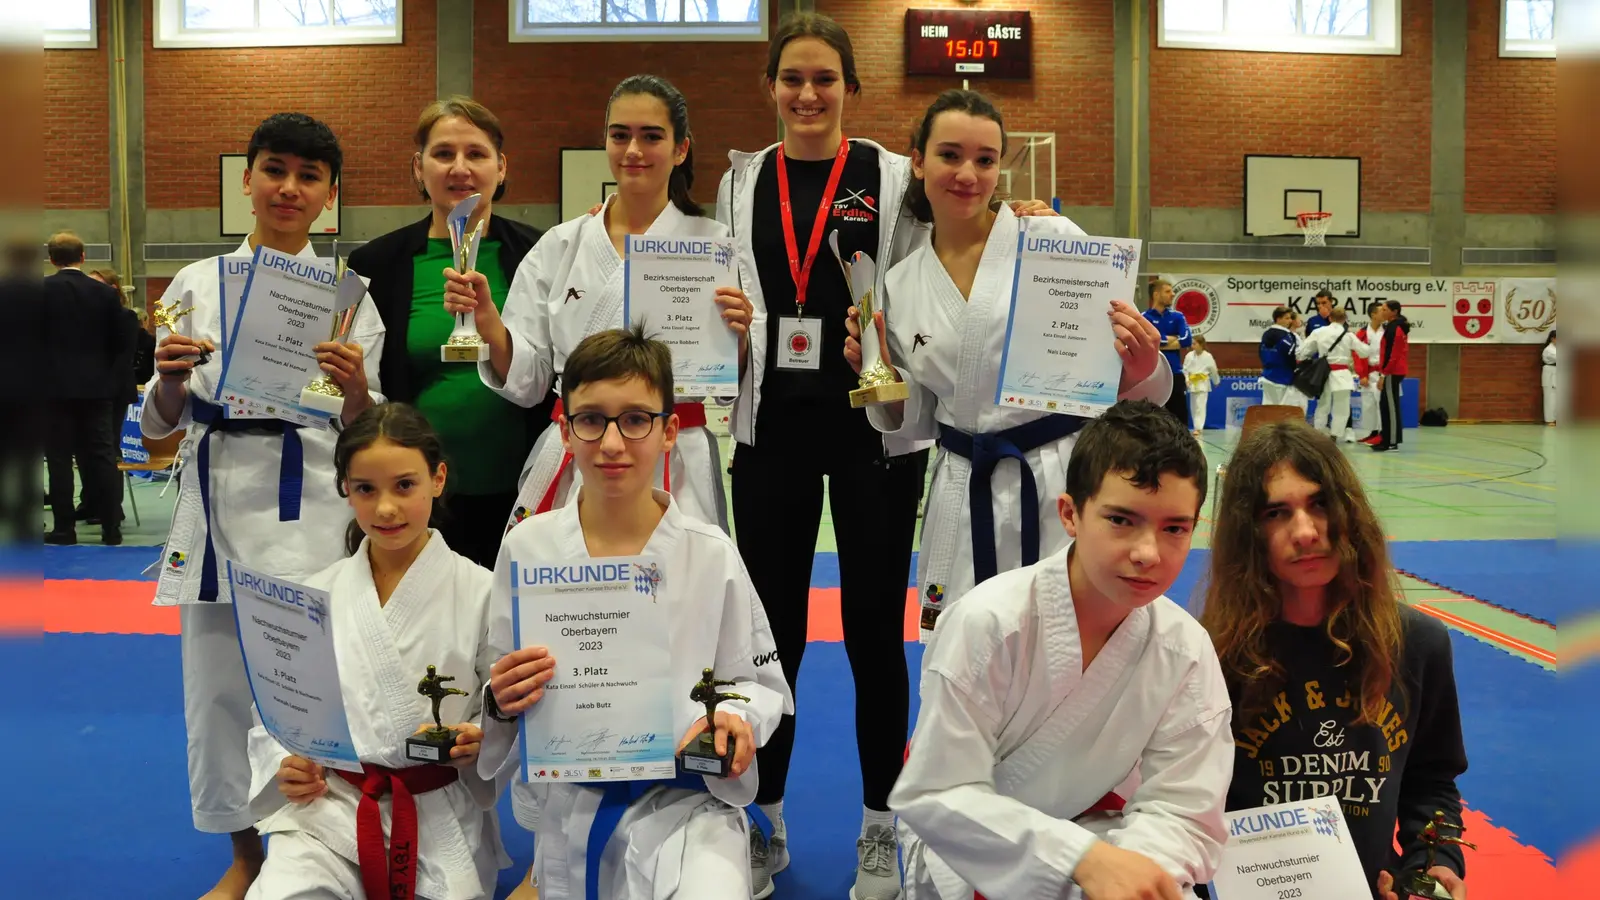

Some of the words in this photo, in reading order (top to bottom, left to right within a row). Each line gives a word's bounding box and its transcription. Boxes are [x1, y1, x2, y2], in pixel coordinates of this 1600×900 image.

[921, 25, 948, 38] HEIM
[987, 24, 1021, 39] GÄSTE
[945, 40, 998, 57] 15:07
[833, 208, 873, 221] Erding
[634, 240, 712, 255] URKUNDE
[1027, 237, 1111, 257] URKUNDE
[643, 274, 715, 283] Bezirksmeisterschaft
[1033, 275, 1109, 288] Bezirksmeisterschaft
[1227, 277, 1351, 293] Sportgemeinschaft
[1356, 279, 1421, 294] Moosburg
[1426, 280, 1447, 292] e.V.
[660, 285, 701, 294] Oberbayern
[1048, 289, 1092, 299] Oberbayern
[269, 290, 332, 314] Nachwuchsturnier
[672, 296, 690, 304] 2023
[1060, 301, 1079, 310] 2023
[1288, 296, 1387, 315] KAAT
[277, 304, 319, 322] Oberbayern
[1517, 300, 1545, 320] 50
[287, 318, 305, 329] 2023
[667, 314, 674, 322] 3.
[675, 314, 693, 322] Platz
[1060, 321, 1079, 331] Platz
[277, 334, 284, 342] 1.
[285, 336, 304, 347] Platz
[524, 563, 630, 585] URKUNDE
[234, 569, 305, 607] URKUNDE
[545, 610, 630, 622] Nachwuchsturnier
[561, 627, 618, 637] Oberbayern
[263, 631, 300, 652] Oberbayern
[579, 641, 603, 651] 2023
[275, 649, 292, 661] 2023
[752, 650, 779, 667] KWO
[281, 671, 297, 683] Platz
[573, 667, 582, 677] 3.
[584, 667, 608, 676] Platz
[606, 680, 638, 688] Nachwuchs
[1304, 680, 1325, 710] &
[576, 702, 595, 710] Jakob
[596, 701, 611, 709] Butz
[1313, 719, 1345, 748] Est
[1259, 759, 1275, 777] 19
[1280, 750, 1371, 776] DENIM
[1378, 755, 1391, 773] 90
[1263, 775, 1388, 807] SUPPLY
[1230, 807, 1309, 837] KUNDE
[1236, 853, 1320, 875] Nachwuchsturnier
[1256, 871, 1312, 888] Oberbayern
[1277, 887, 1302, 900] 2023
